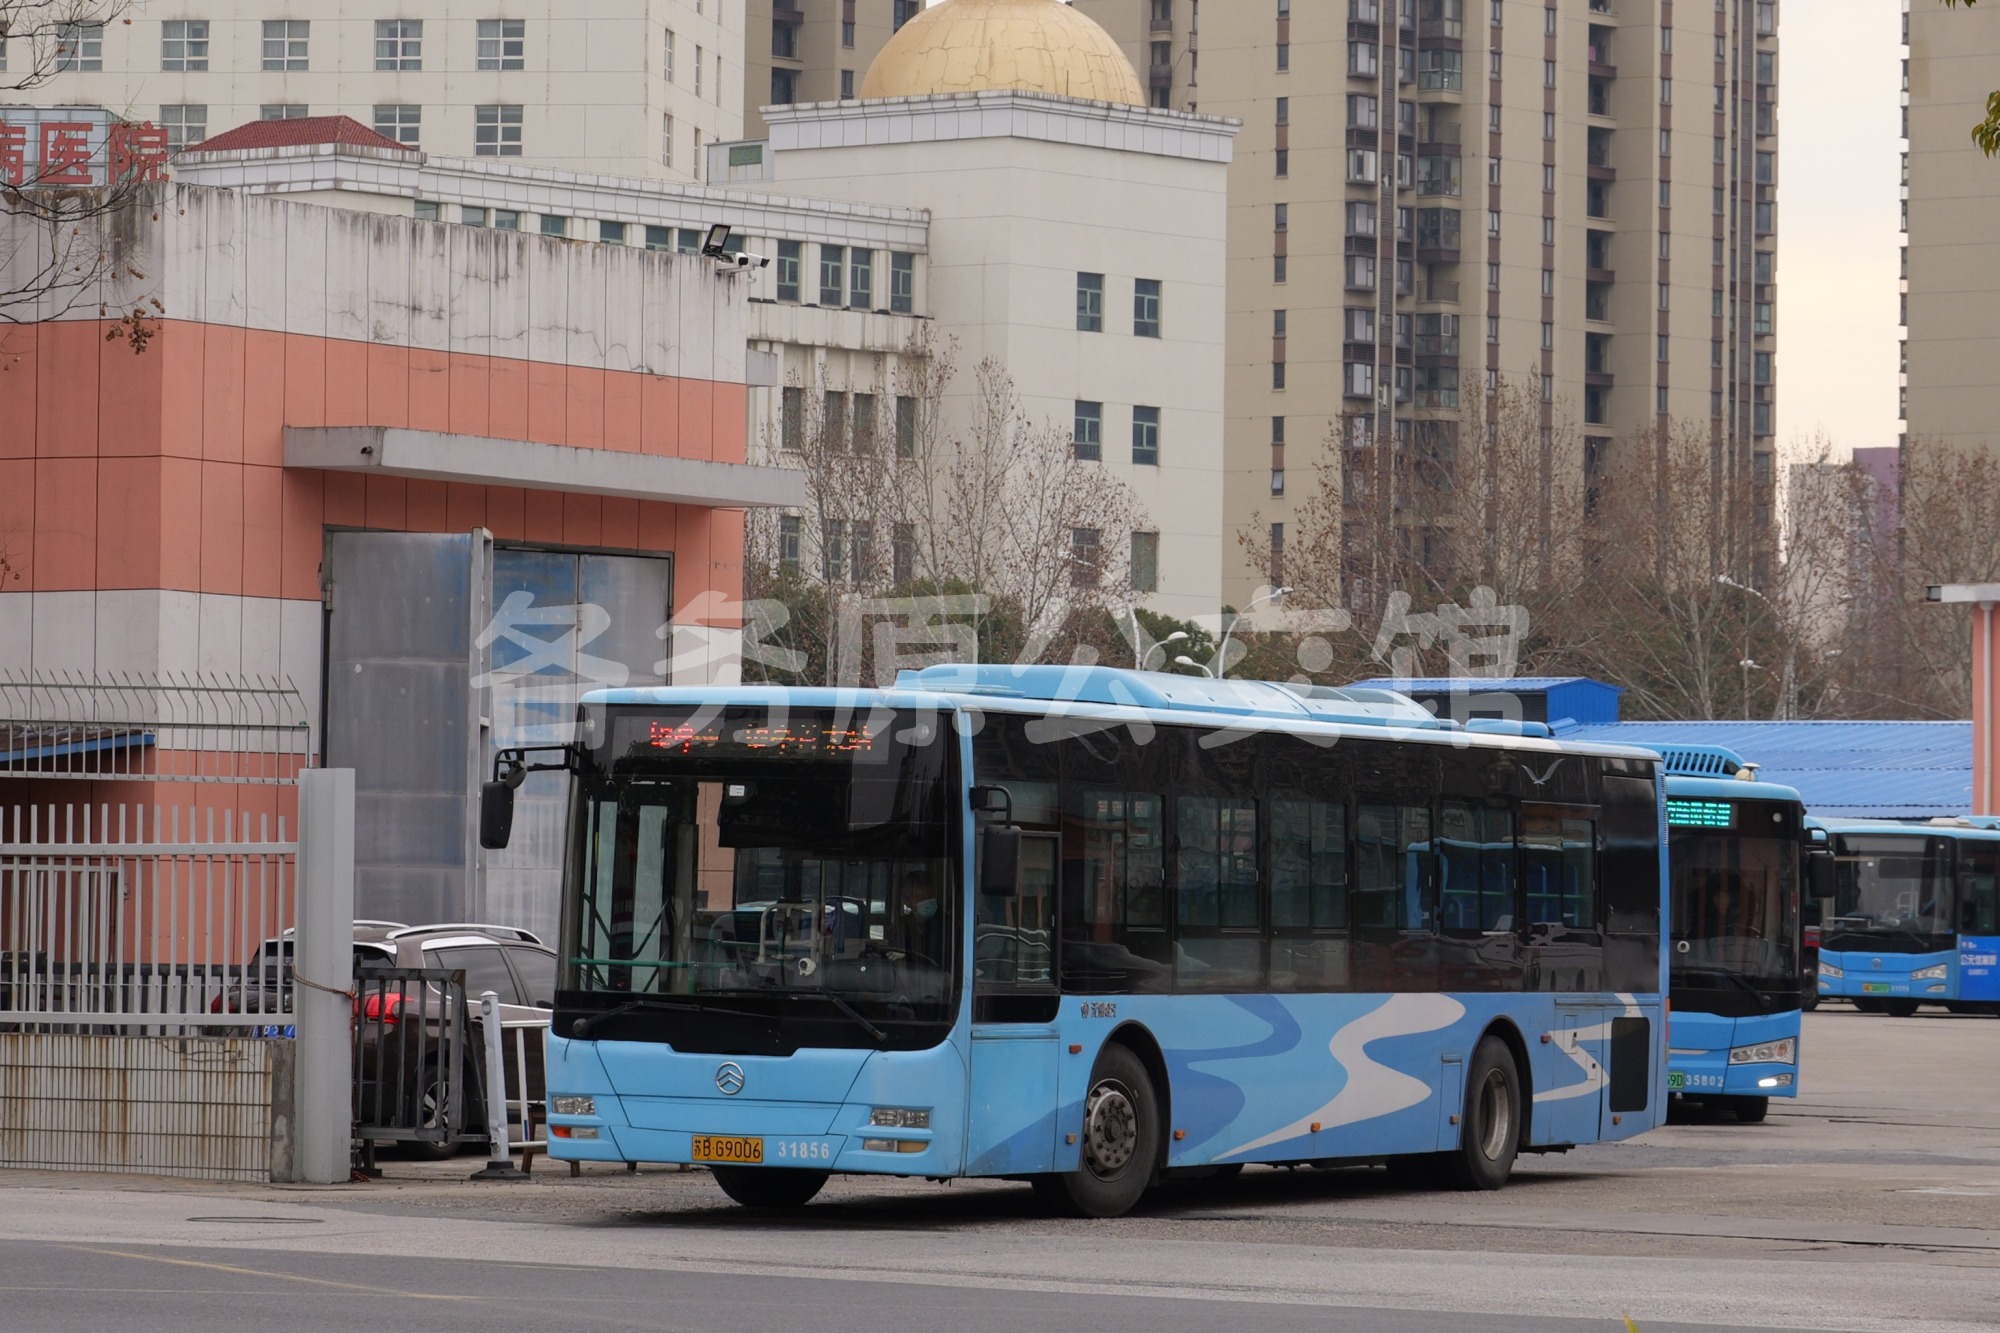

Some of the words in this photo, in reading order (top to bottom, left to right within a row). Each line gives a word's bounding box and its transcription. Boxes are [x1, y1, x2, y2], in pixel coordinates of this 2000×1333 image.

[1668, 1074, 1683, 1087] 9D
[1685, 1074, 1725, 1088] 35802
[778, 1140, 830, 1160] 31856
